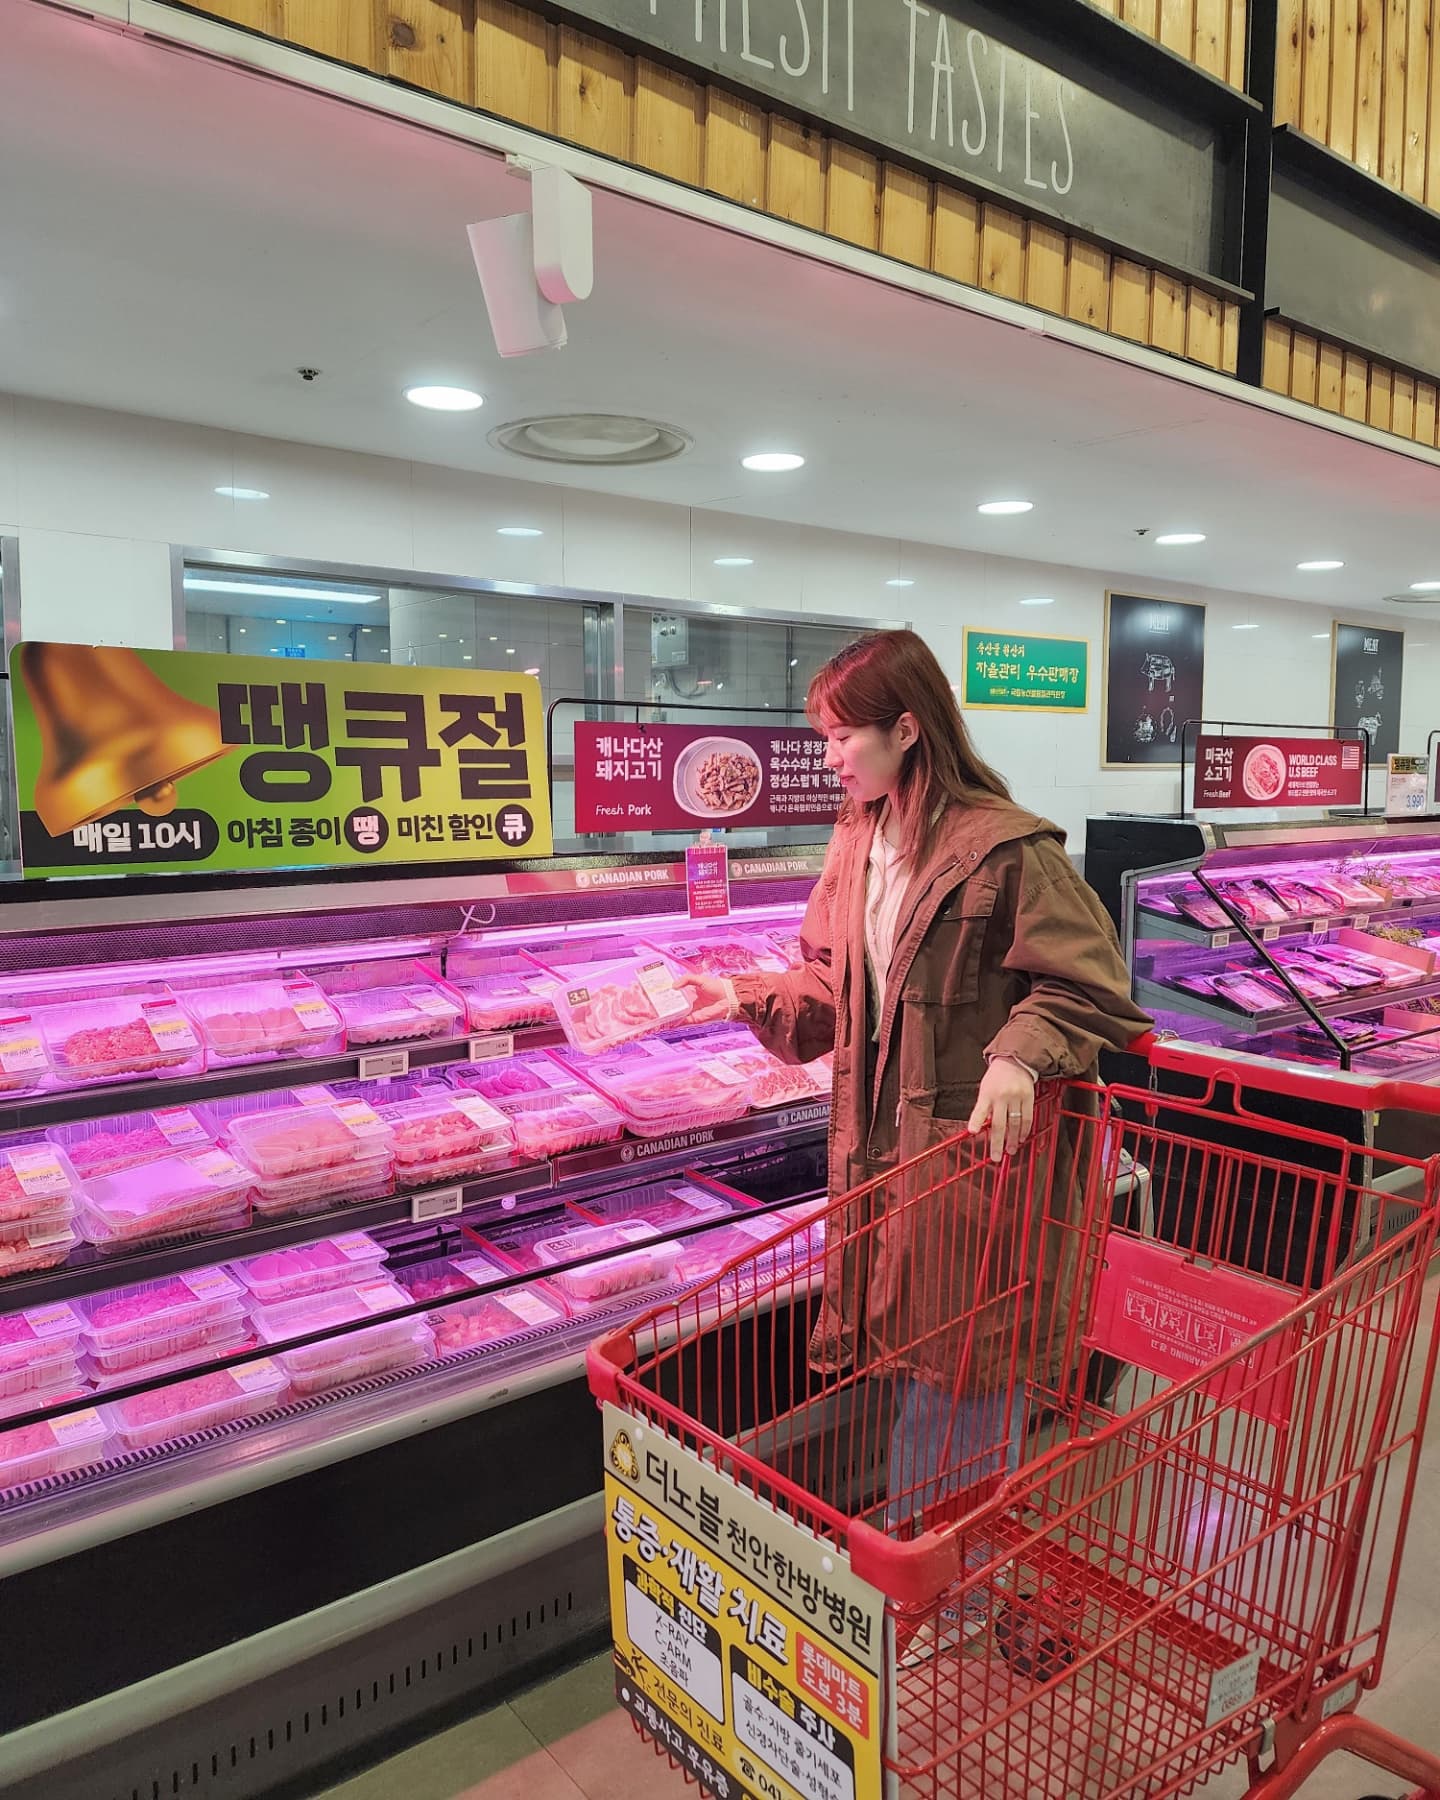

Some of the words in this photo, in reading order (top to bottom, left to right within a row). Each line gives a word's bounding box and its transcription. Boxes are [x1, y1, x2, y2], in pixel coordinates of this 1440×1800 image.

[904, 0, 1075, 194] TASTES
[976, 661, 1020, 680] 자율관리
[1026, 664, 1080, 684] 우수판매장
[217, 682, 532, 803] 땡큐절
[596, 736, 663, 758] 캐나다산
[770, 739, 801, 755] 캐나다
[1205, 747, 1233, 764] 미국산
[595, 759, 662, 781] 돼지고기
[770, 757, 811, 772] 옥수수와
[1203, 765, 1233, 782] 소고기
[1289, 754, 1314, 766] WORLD
[1315, 754, 1337, 766] CLASS
[1301, 766, 1319, 777] BEEF
[770, 773, 820, 789] 정성스럽게
[1218, 789, 1232, 798] Beef
[595, 803, 625, 816] Fresh
[627, 803, 652, 816] Pork
[73, 822, 133, 853] 매일
[138, 820, 202, 850] 10시
[227, 817, 283, 849] 아침
[397, 814, 445, 843] 미친
[591, 870, 643, 885] CANADIAN
[644, 869, 669, 882] PORK
[744, 861, 786, 874] CANADIAN
[787, 860, 809, 872] PORK
[636, 1135, 688, 1157] CANADIAN
[689, 1129, 714, 1144] PORK
[646, 1450, 724, 1544] 더노블
[726, 1518, 872, 1656] 천안한방병원
[636, 1567, 675, 1617] 과학적
[678, 1602, 708, 1644] 진단
[655, 1611, 689, 1649] X-RAY
[727, 1587, 789, 1666] 치료
[655, 1630, 692, 1672] C-ARM
[660, 1652, 688, 1688] 초음파
[801, 1642, 864, 1703] 롯데마트
[747, 1659, 795, 1719] 비수술
[800, 1703, 836, 1750] 주사
[802, 1667, 833, 1704] 도보
[835, 1692, 863, 1730] 3분
[654, 1675, 693, 1729] 전문의
[697, 1715, 726, 1756] 진료
[634, 1693, 686, 1756] 교통사고
[687, 1743, 731, 1799] 후유증
[794, 1737, 843, 1789] 줄기세포
